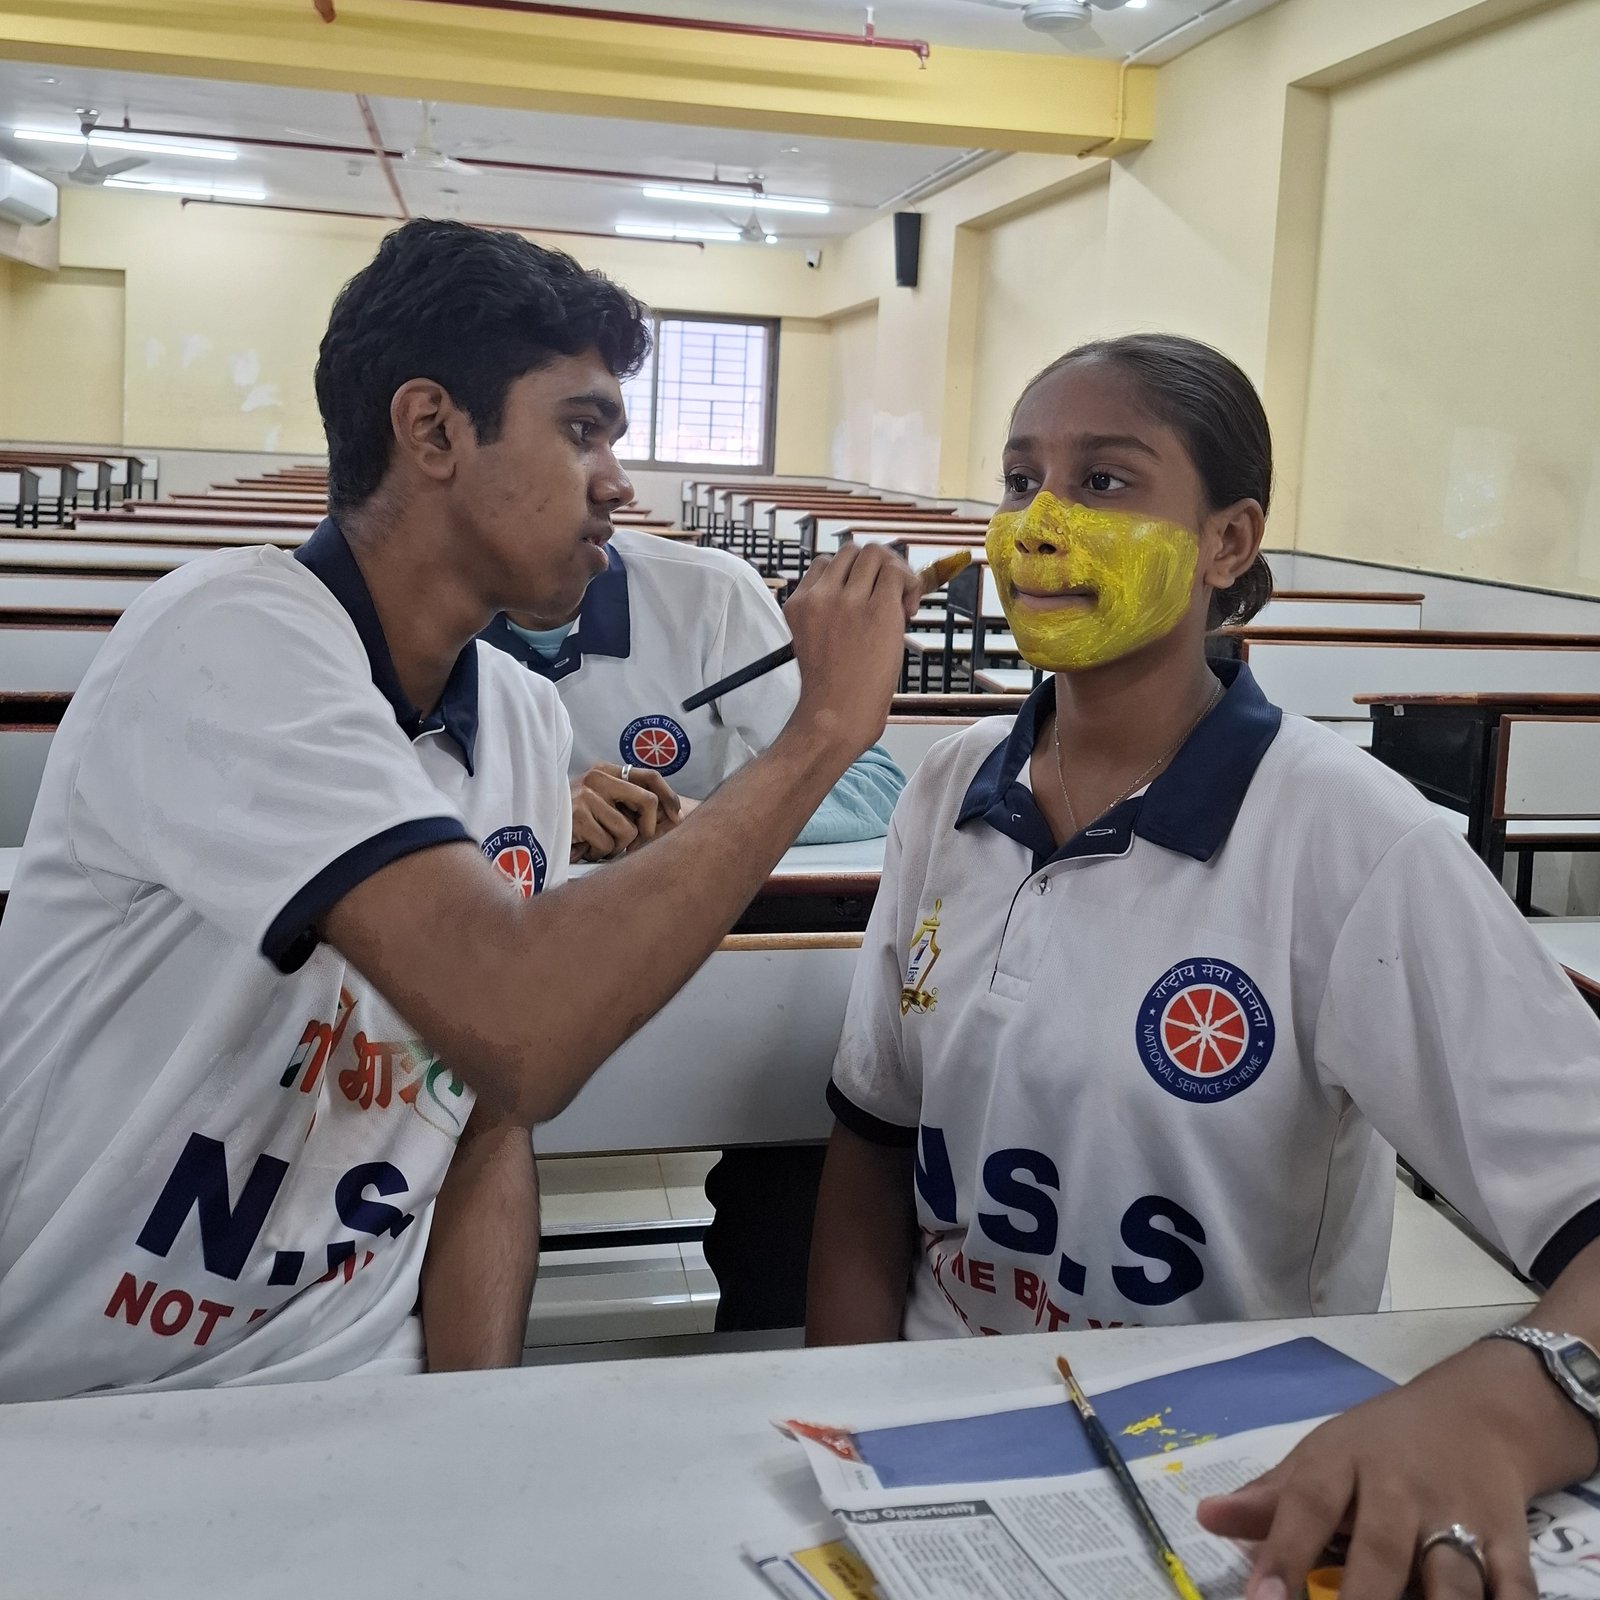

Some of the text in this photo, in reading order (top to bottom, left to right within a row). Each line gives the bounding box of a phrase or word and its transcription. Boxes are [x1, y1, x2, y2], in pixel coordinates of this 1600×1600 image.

[1152, 958, 1268, 1028] राष्ट्रीय सेवा योजना
[1143, 1024, 1264, 1095] NATIONAL SERVICE SCHEME
[104, 1271, 234, 1346] NOT
[881, 1503, 977, 1520] Opportunity
